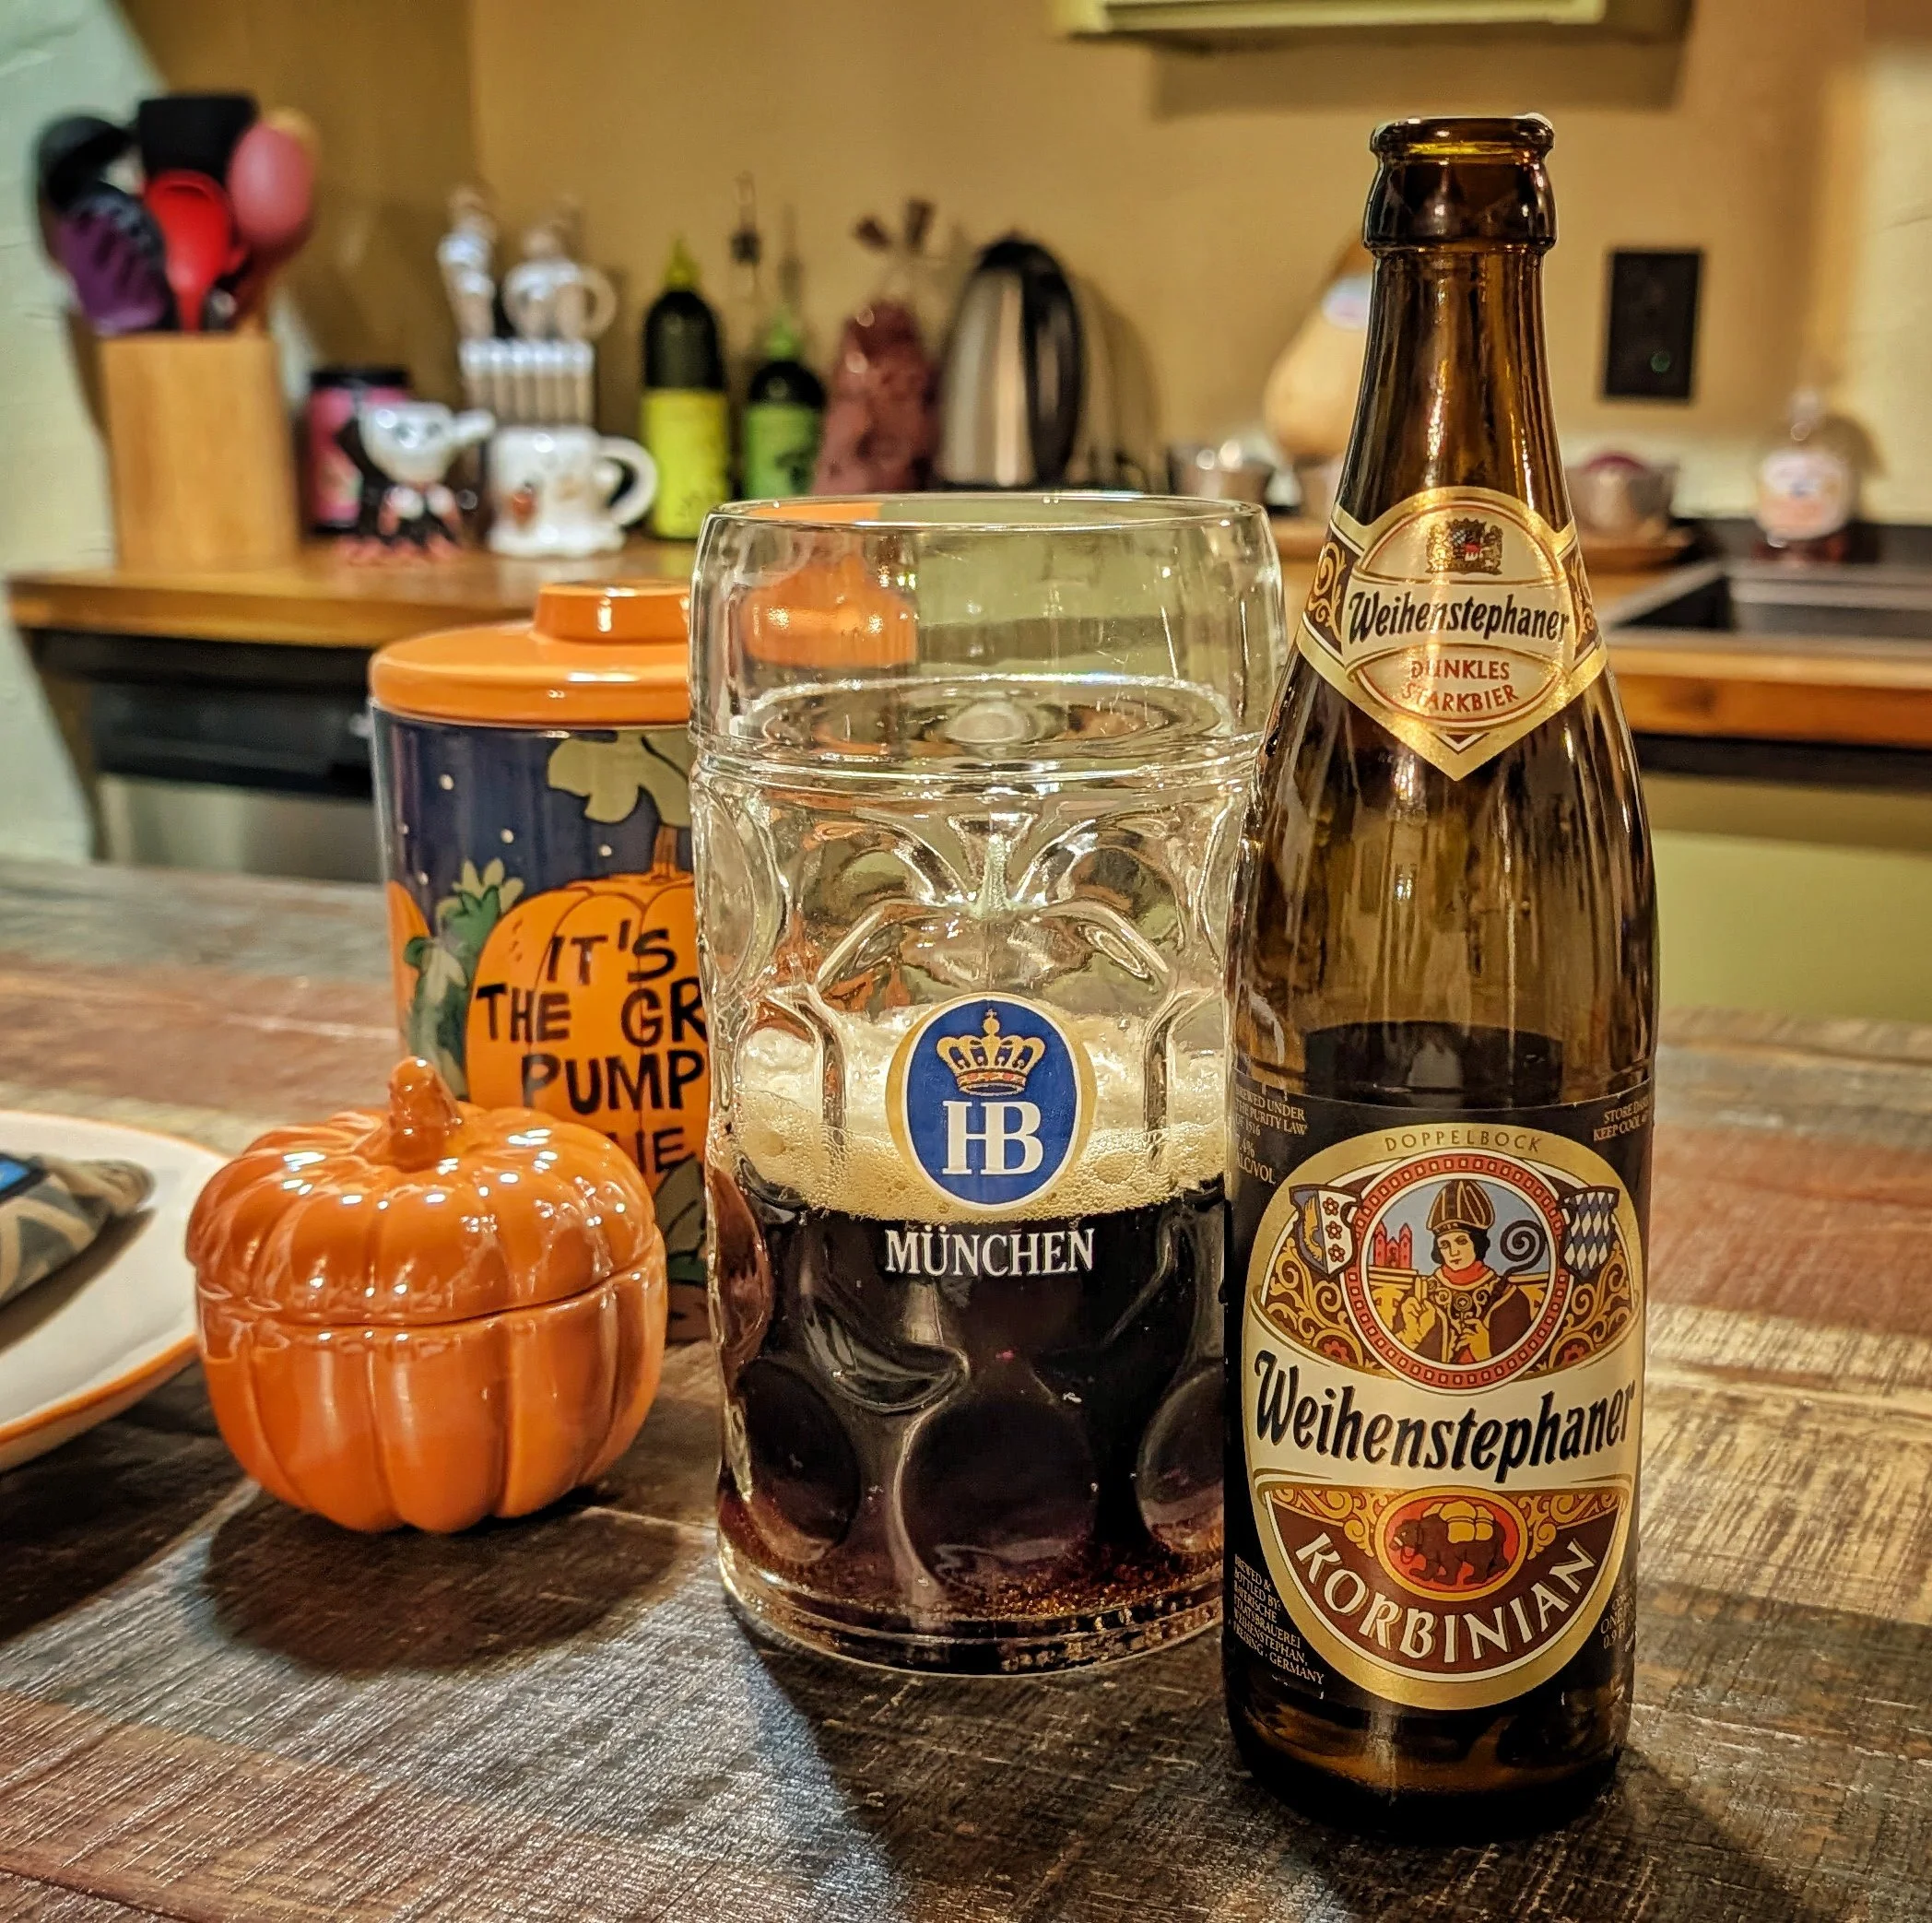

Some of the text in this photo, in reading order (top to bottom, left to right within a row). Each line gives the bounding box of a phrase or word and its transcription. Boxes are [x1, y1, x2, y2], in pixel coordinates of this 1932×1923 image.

[1348, 591, 1569, 644] Weihenstephaner
[1411, 659, 1510, 680] DUNKLES
[1403, 684, 1518, 713] STARKBIER
[547, 919, 677, 985] IT'S
[476, 983, 571, 1044] THE
[1250, 1106, 1282, 1129] PURITY
[1283, 1119, 1308, 1136] LAW
[1266, 1099, 1306, 1121] UNDER
[942, 1101, 1043, 1175] HB
[1384, 1129, 1542, 1153] DOPPELBOCK
[1593, 1124, 1618, 1142] KEEP
[884, 1225, 1095, 1278] MÜNCHEN
[1254, 1350, 1636, 1484] Weihenstephaner
[1295, 1532, 1599, 1664] KORBINIAN
[1269, 1652, 1325, 1685] GERMANY
